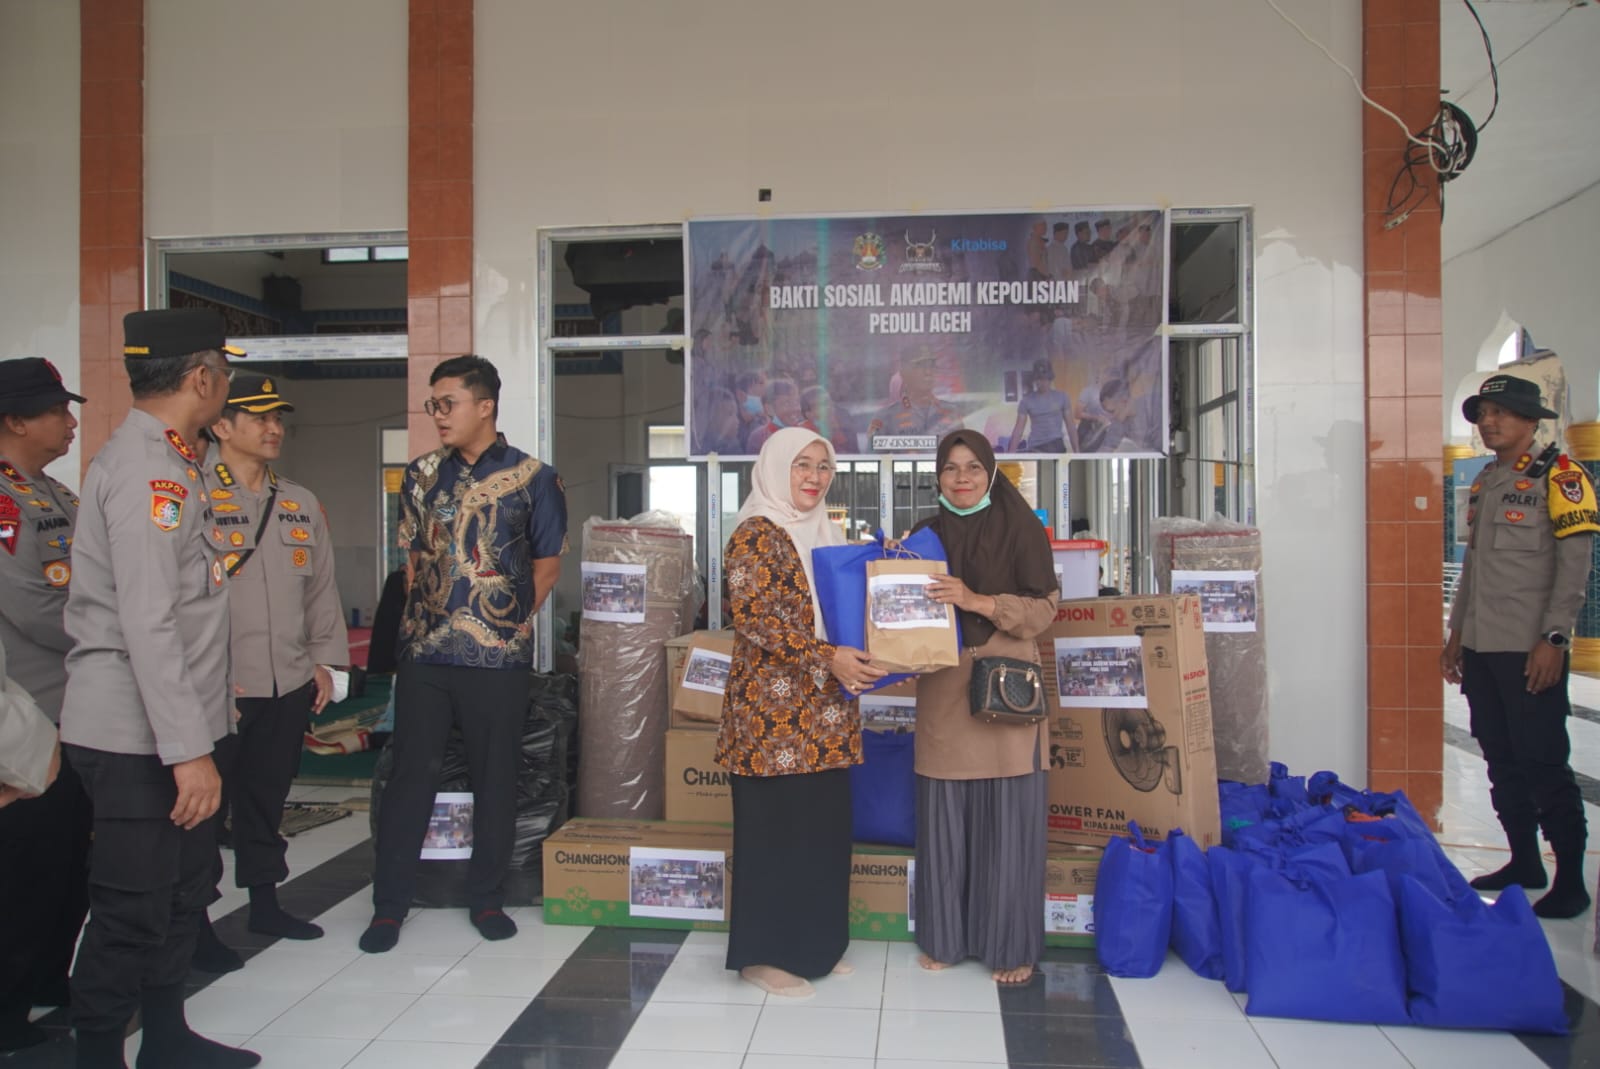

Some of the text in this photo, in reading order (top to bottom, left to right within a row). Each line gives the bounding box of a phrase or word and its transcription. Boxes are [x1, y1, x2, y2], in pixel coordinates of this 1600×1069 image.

[951, 238, 1007, 251] Kitabisa
[769, 280, 1080, 309] BAKTI SOSIAL AKADEMI KEPOLISIAN
[869, 311, 971, 334] PEDULI ACEH
[154, 481, 185, 496] AKPOL
[1502, 494, 1537, 507] POLRI
[278, 513, 311, 524] POLRI
[1096, 808, 1126, 821] FAN
[1083, 820, 1109, 832] KIPAS
[850, 863, 908, 877] ANGHON
